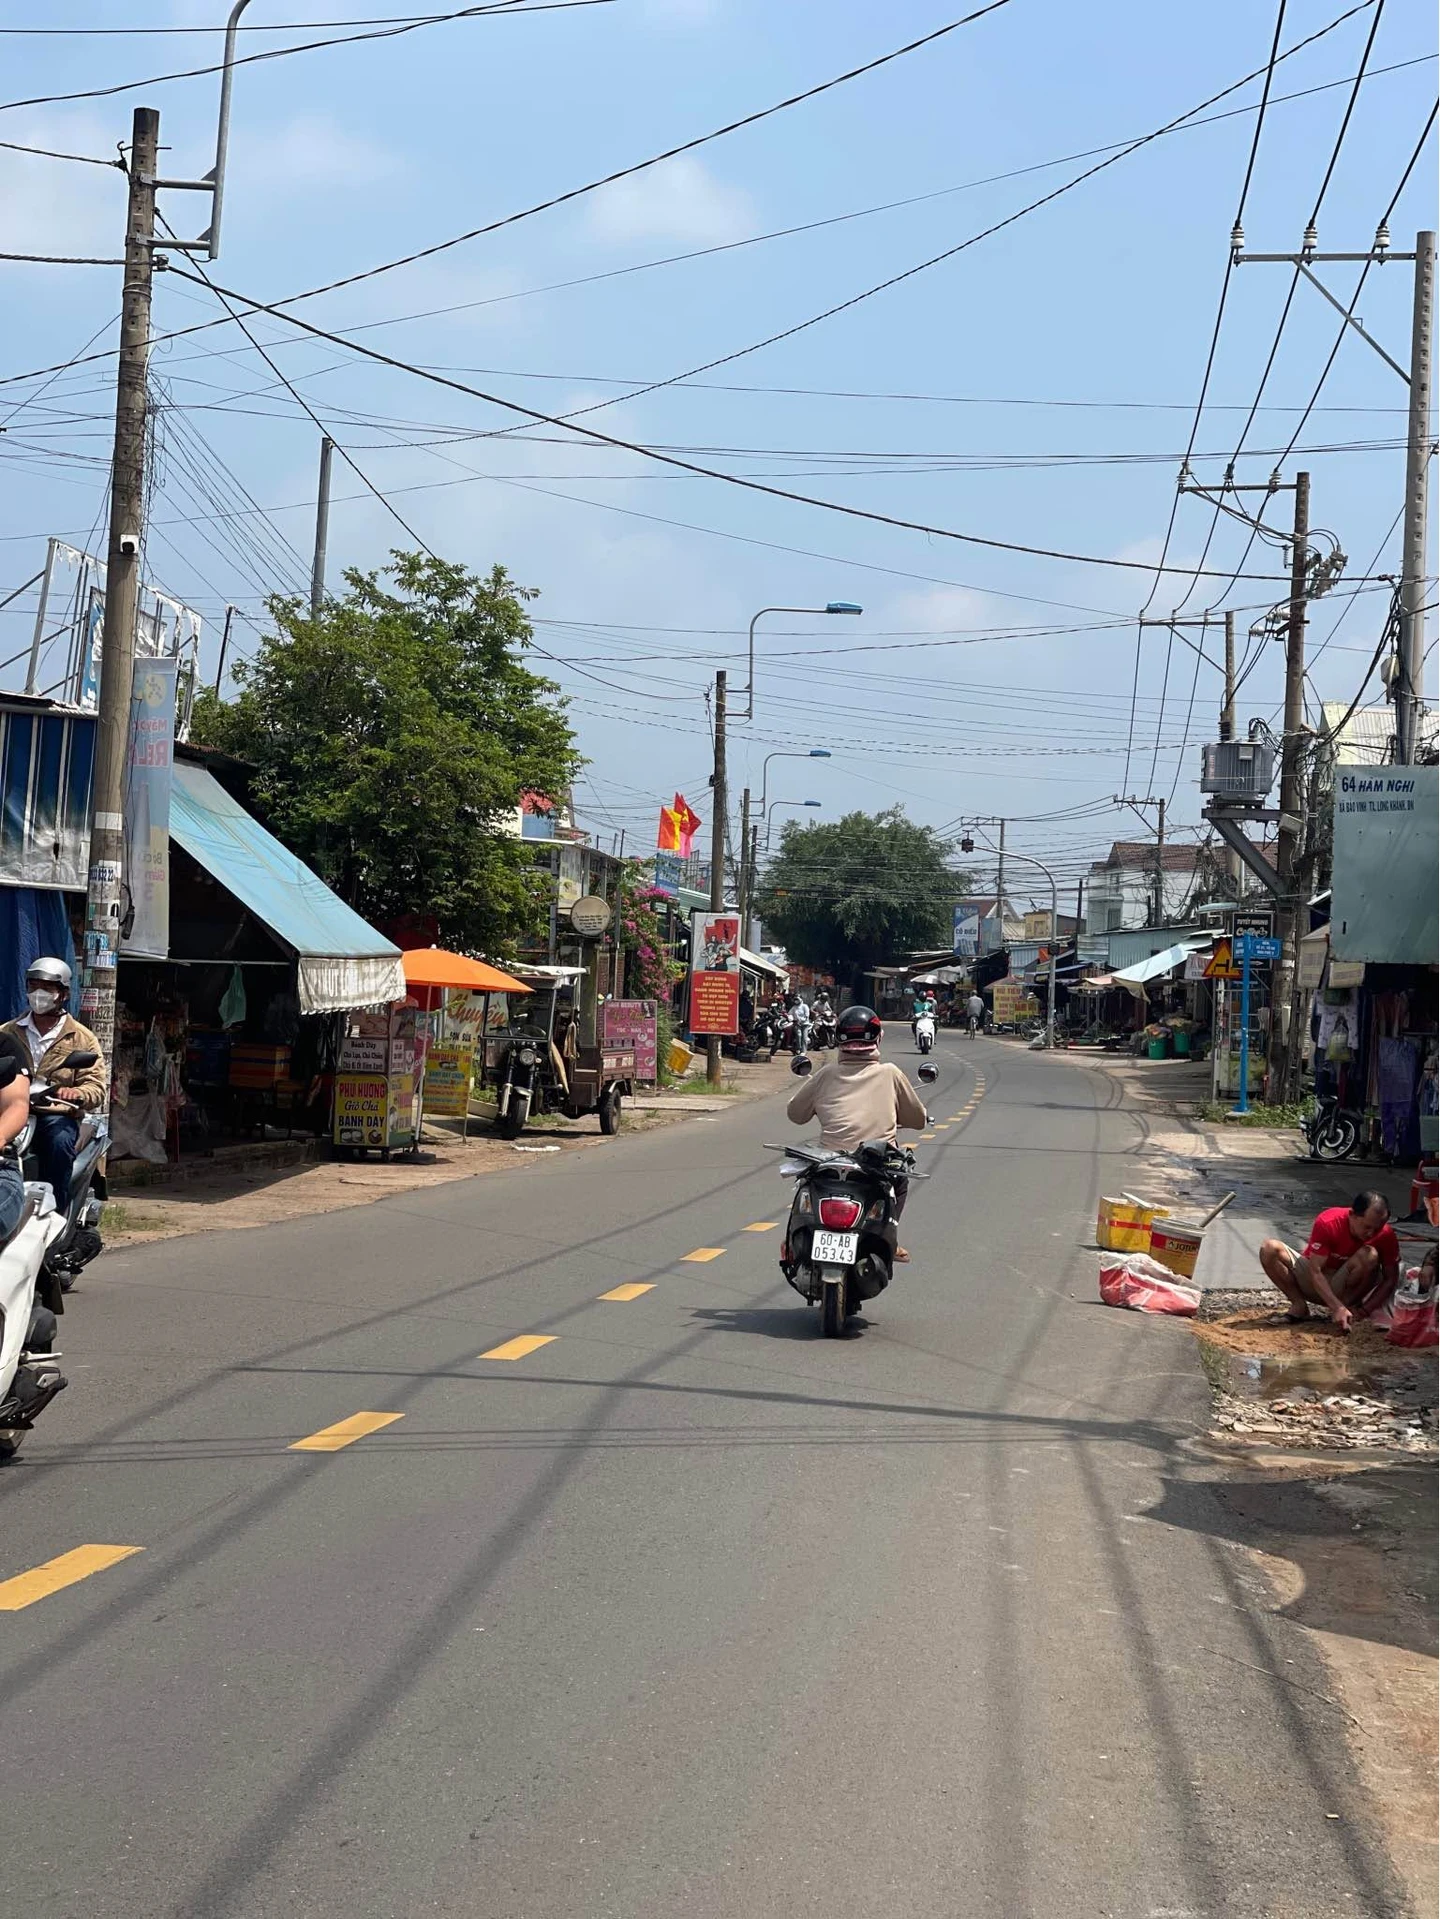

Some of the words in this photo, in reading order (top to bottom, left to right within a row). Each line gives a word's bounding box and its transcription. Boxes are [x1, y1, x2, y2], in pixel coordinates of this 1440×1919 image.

[1341, 776, 1356, 792] 64
[1387, 779, 1415, 793] NGHI
[814, 1246, 854, 1262] 053.43
